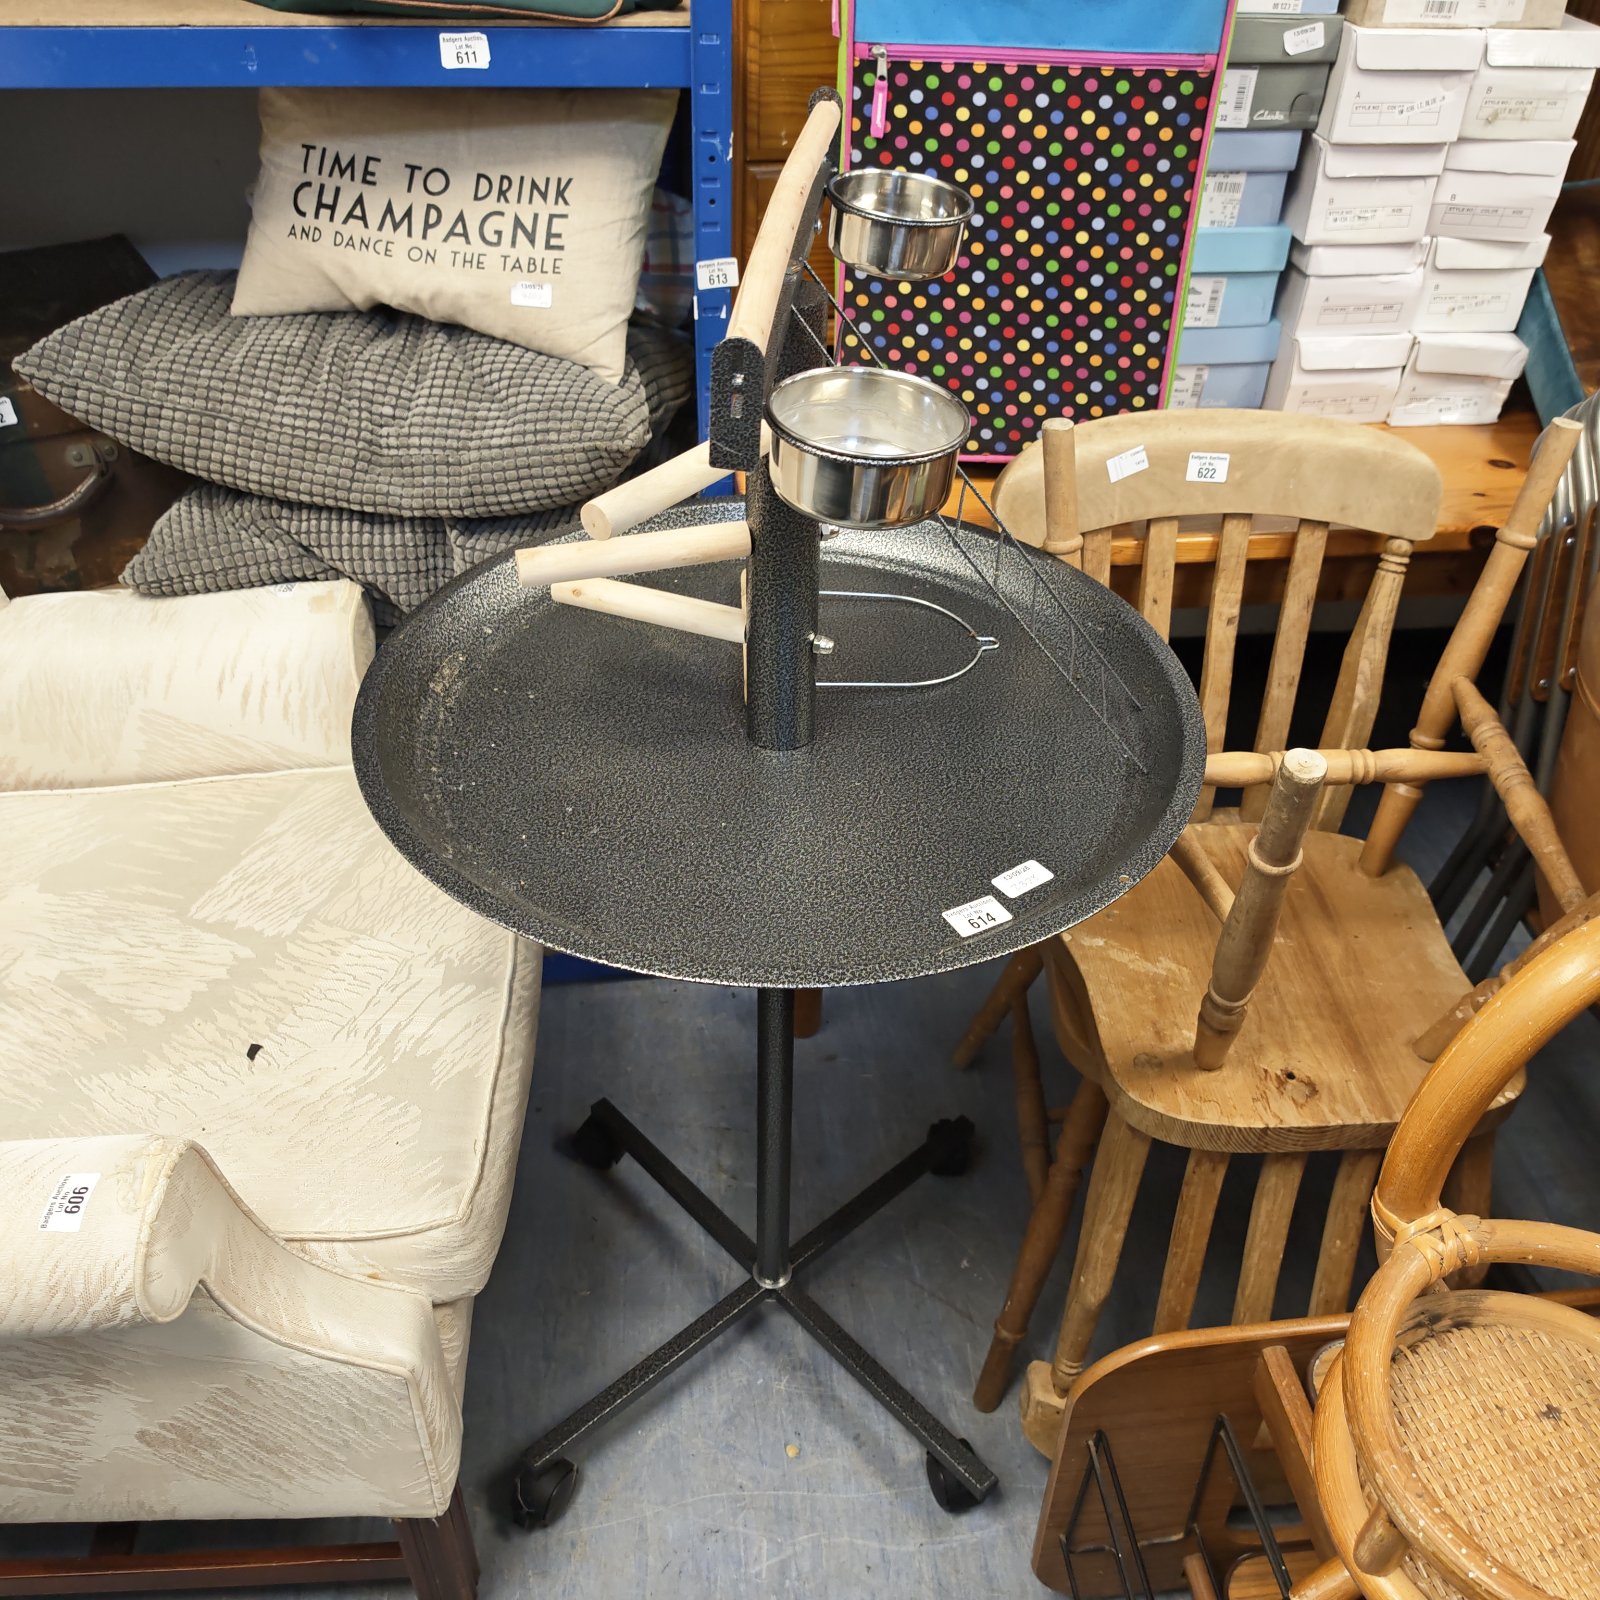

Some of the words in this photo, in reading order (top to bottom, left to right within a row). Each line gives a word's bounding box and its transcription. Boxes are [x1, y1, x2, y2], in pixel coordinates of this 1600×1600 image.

[456, 50, 477, 65] 611
[1253, 110, 1284, 121] Clarks
[301, 143, 381, 187] TIME
[405, 163, 450, 197] TO
[473, 172, 574, 206] DRINK
[293, 181, 569, 252] CHAMPAGNE
[287, 223, 322, 243] AND
[333, 230, 395, 258] DANCE
[407, 246, 437, 264] ON
[451, 250, 487, 270] THE
[500, 254, 564, 275] TABLE
[708, 272, 729, 286] 613
[1197, 467, 1217, 480] 622
[968, 912, 997, 929] 614
[40, 1201, 56, 1229] Badgers
[52, 1175, 71, 1200] Auctions
[55, 1202, 66, 1213] Lot
[64, 1186, 89, 1215] 606
